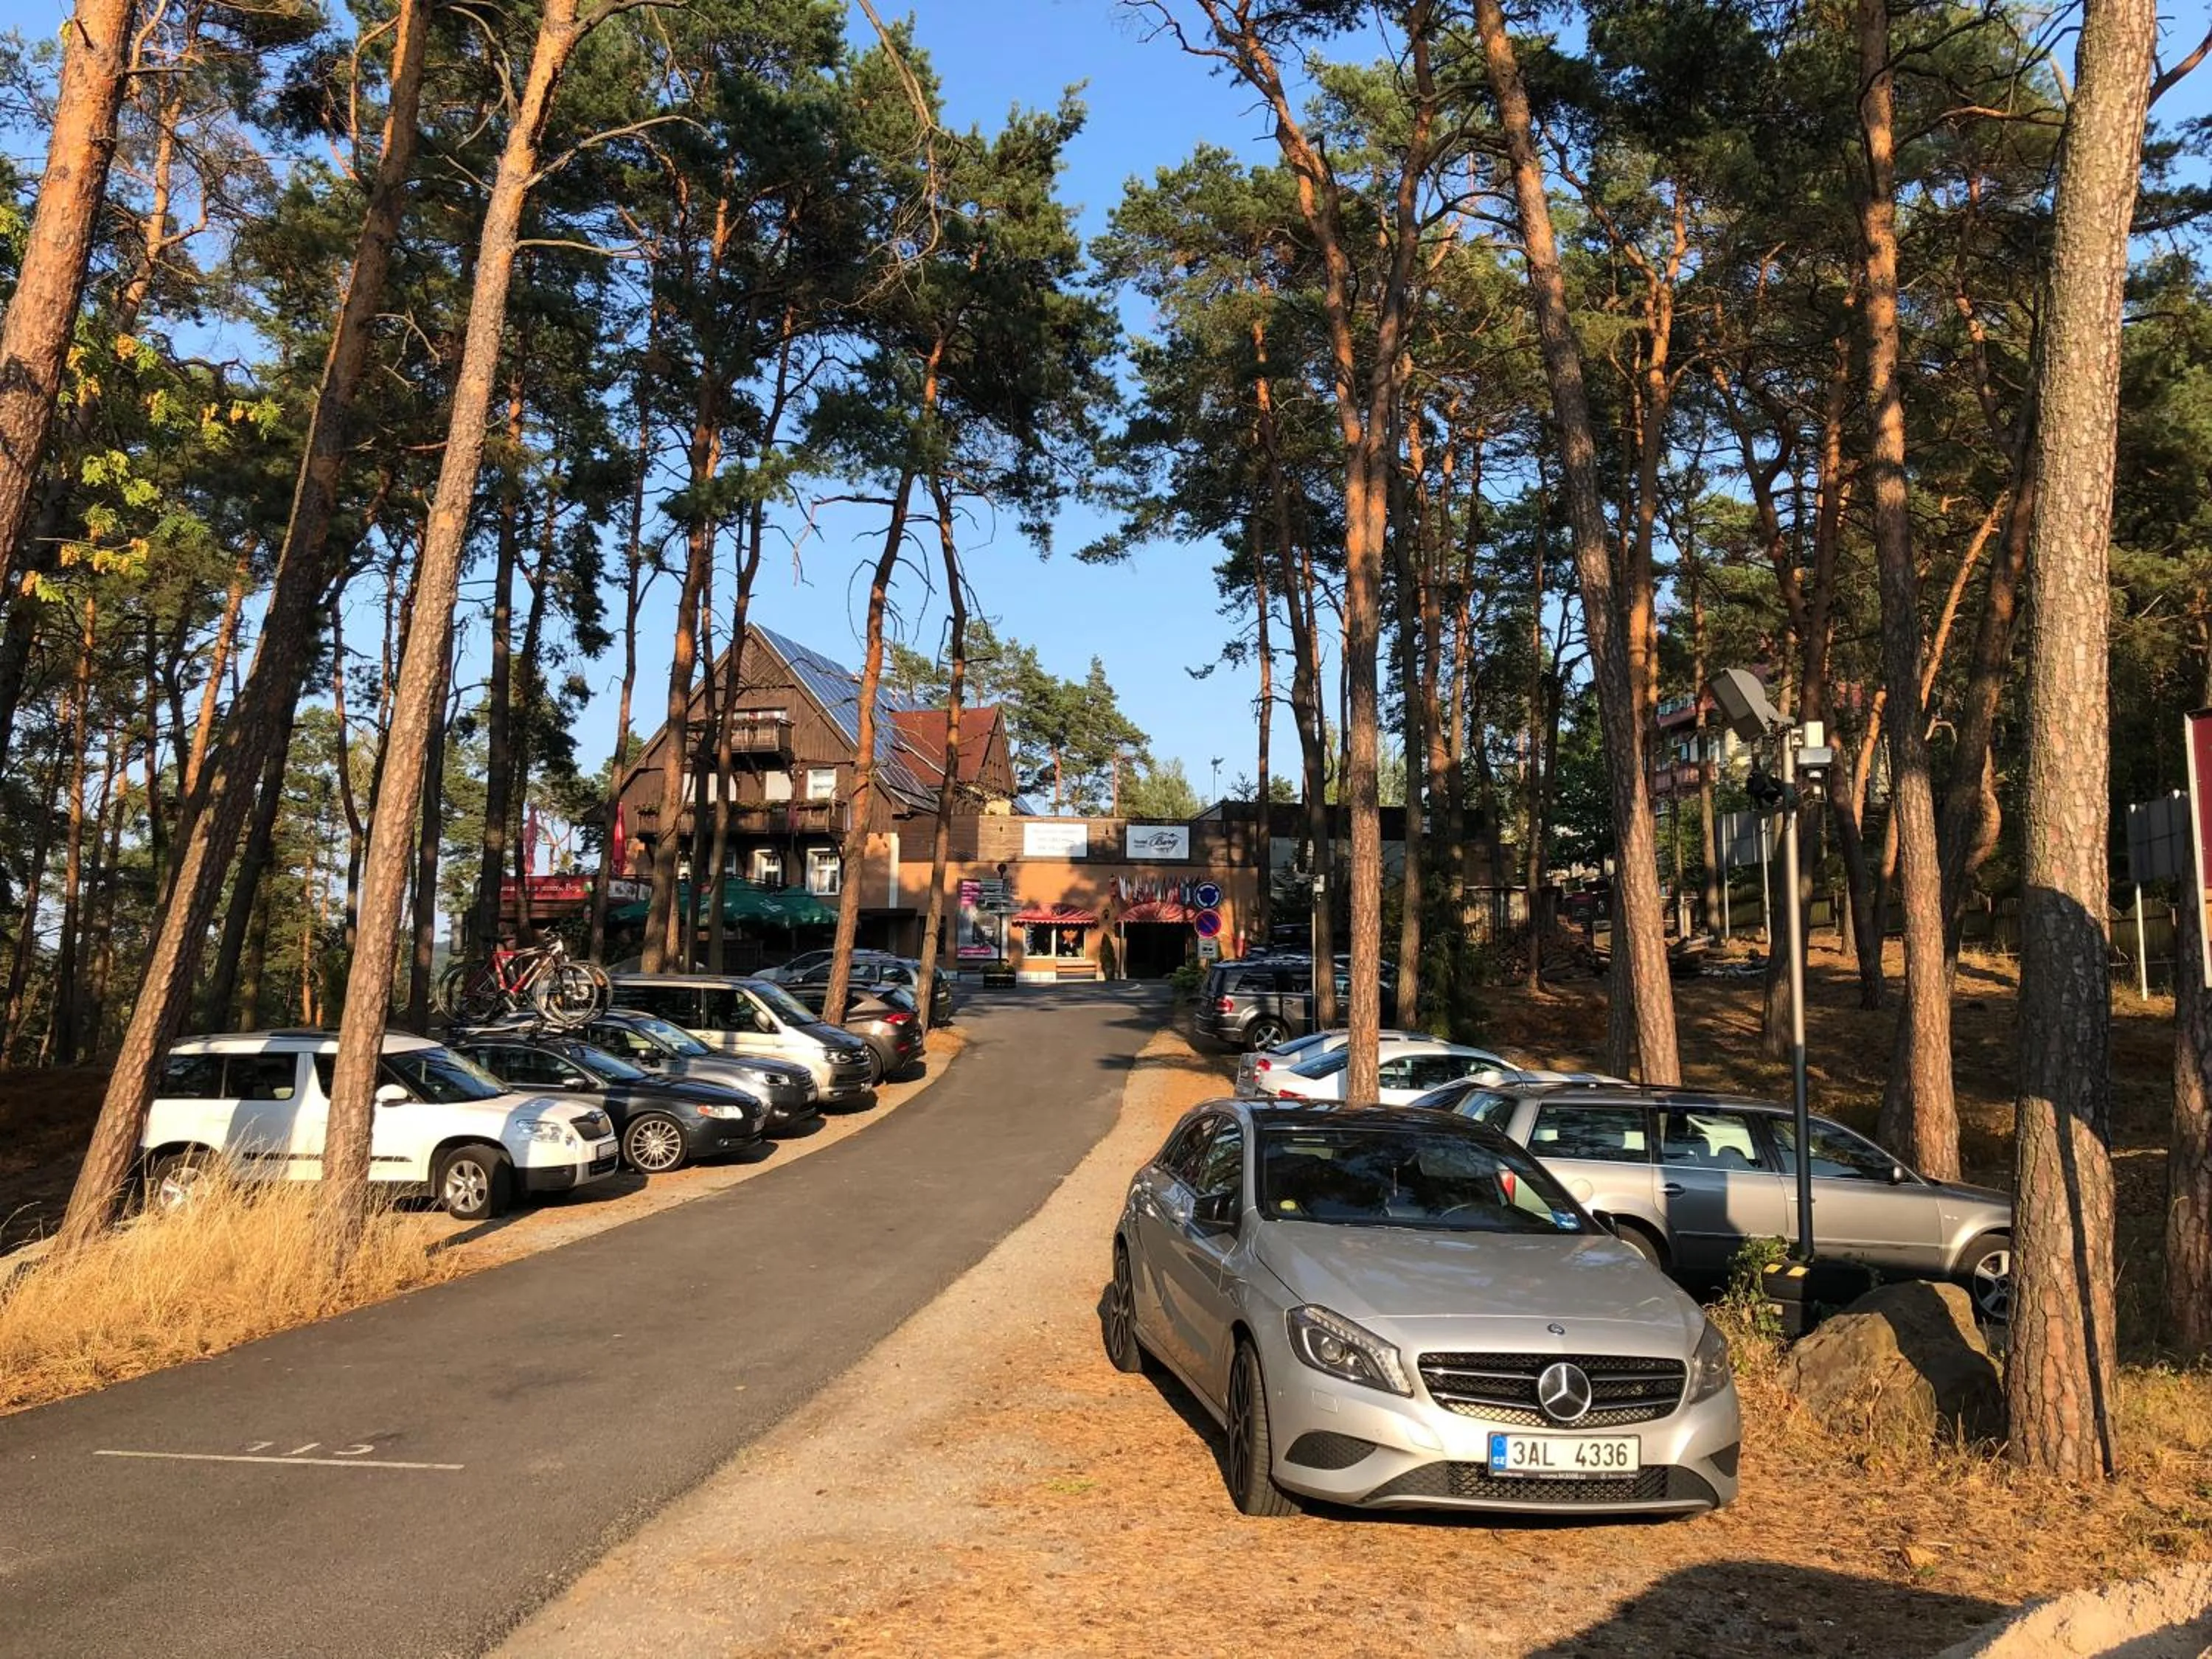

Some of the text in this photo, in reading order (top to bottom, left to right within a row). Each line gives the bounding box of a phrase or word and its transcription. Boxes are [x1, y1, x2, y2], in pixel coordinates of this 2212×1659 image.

[1493, 1456, 1505, 1465] CZ
[1513, 1441, 1627, 1467] 3AL 4336
